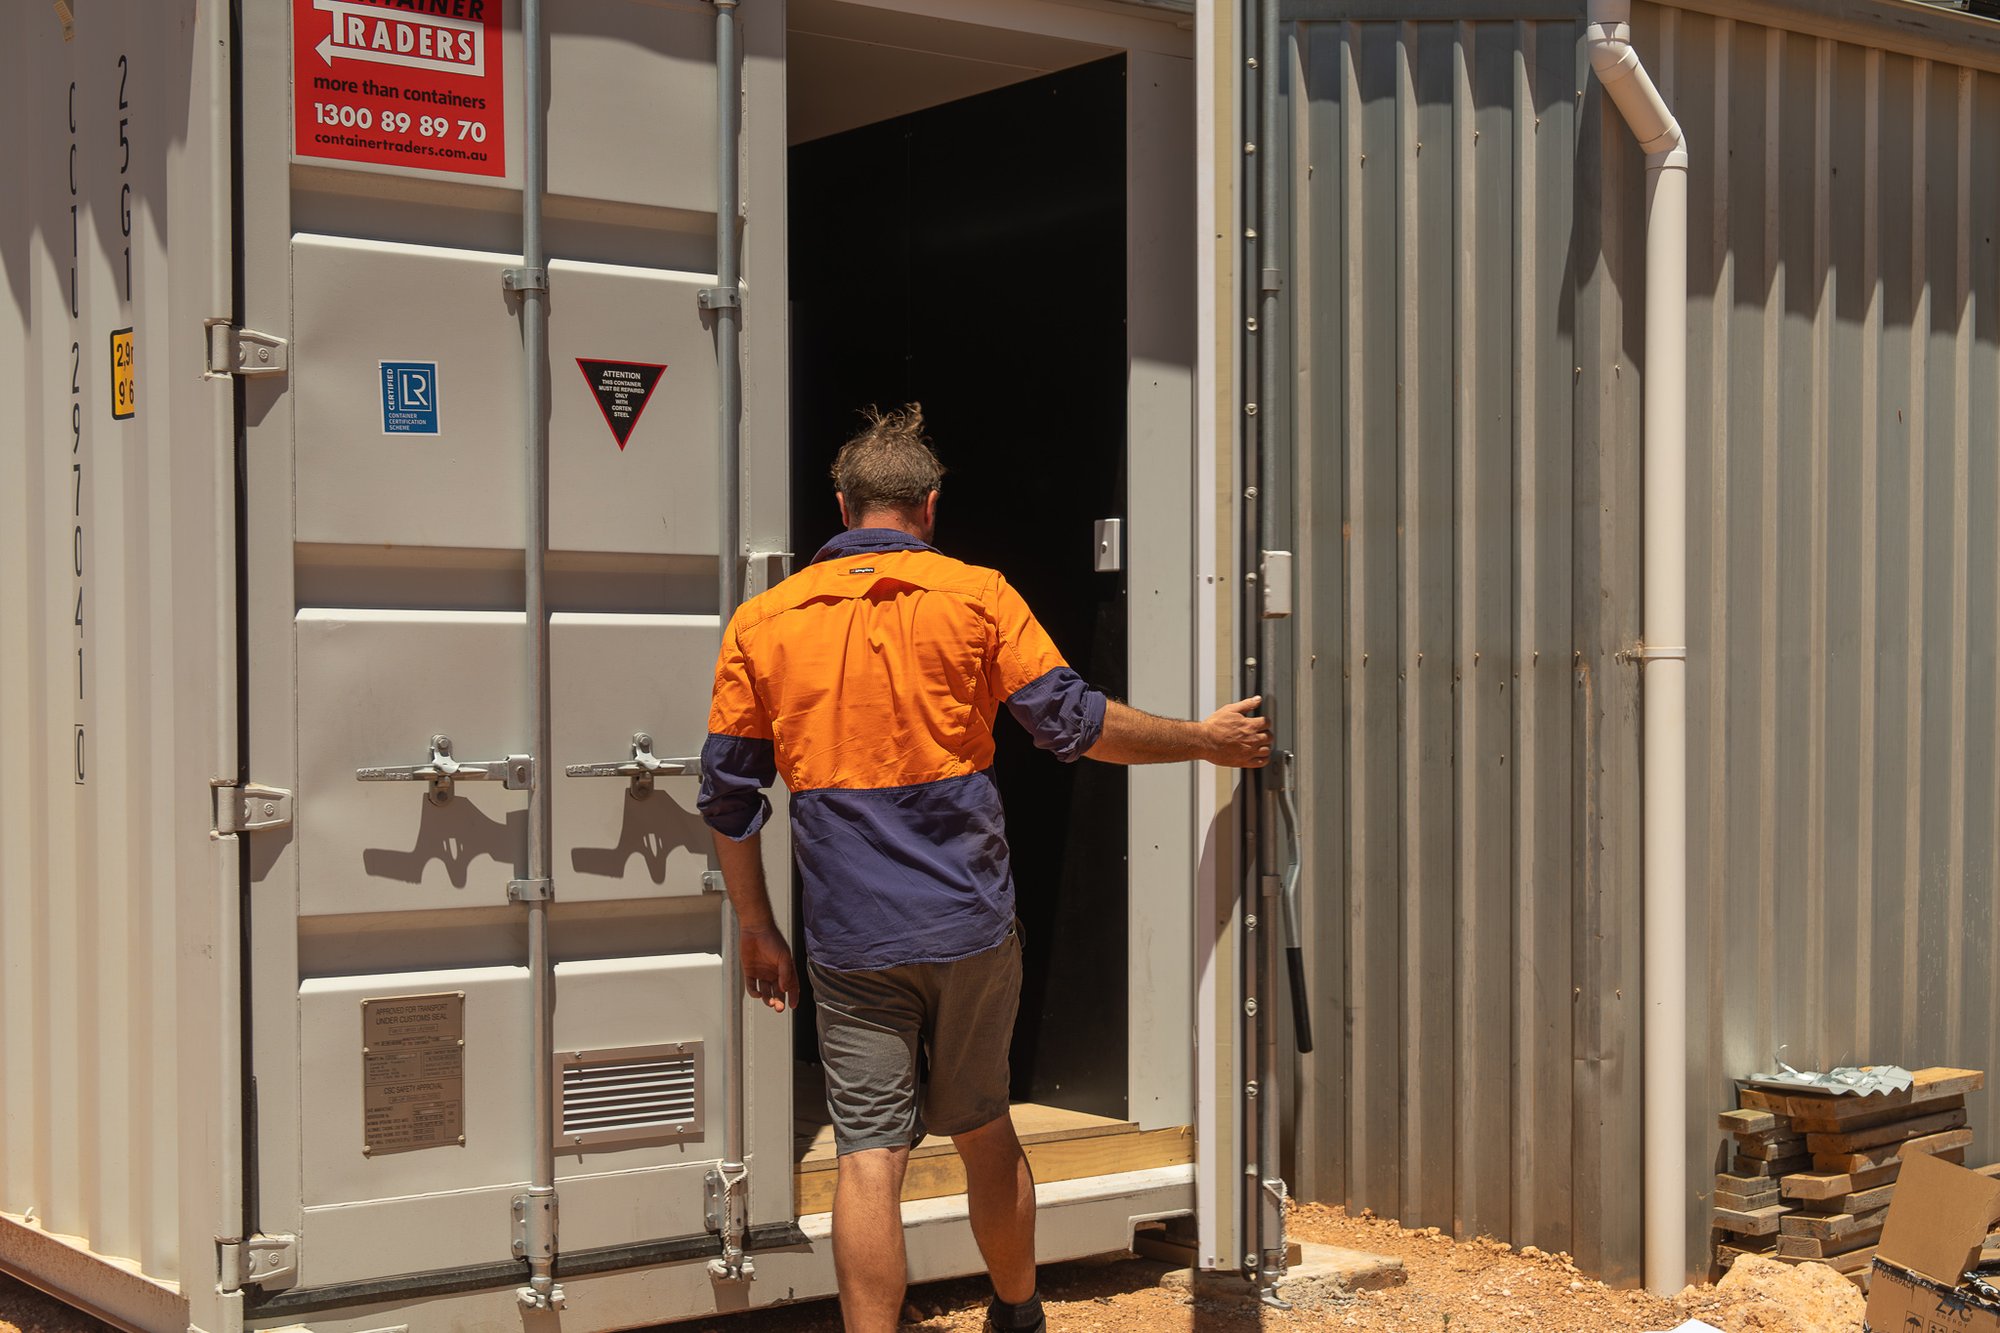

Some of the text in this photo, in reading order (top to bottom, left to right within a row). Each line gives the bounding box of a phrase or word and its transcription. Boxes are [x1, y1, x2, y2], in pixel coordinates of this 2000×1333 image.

[332, 11, 473, 61] TRADERS
[313, 76, 486, 109] more than containers
[314, 102, 486, 142] 1300 89 89 70
[315, 133, 487, 161] containertraders.com.au
[118, 54, 131, 301] 25G1
[387, 368, 395, 411] CERTIFIED
[403, 374, 429, 406] LR
[603, 370, 641, 380] ATTENTION
[376, 1003, 448, 1016] APPROVED FOR TRANSPORT
[376, 1012, 448, 1025] UNDER CUSTOMS SEAL
[383, 1082, 444, 1095] CSC SAFETY APPROVAL
[1936, 1312, 1968, 1329] ENERGY
